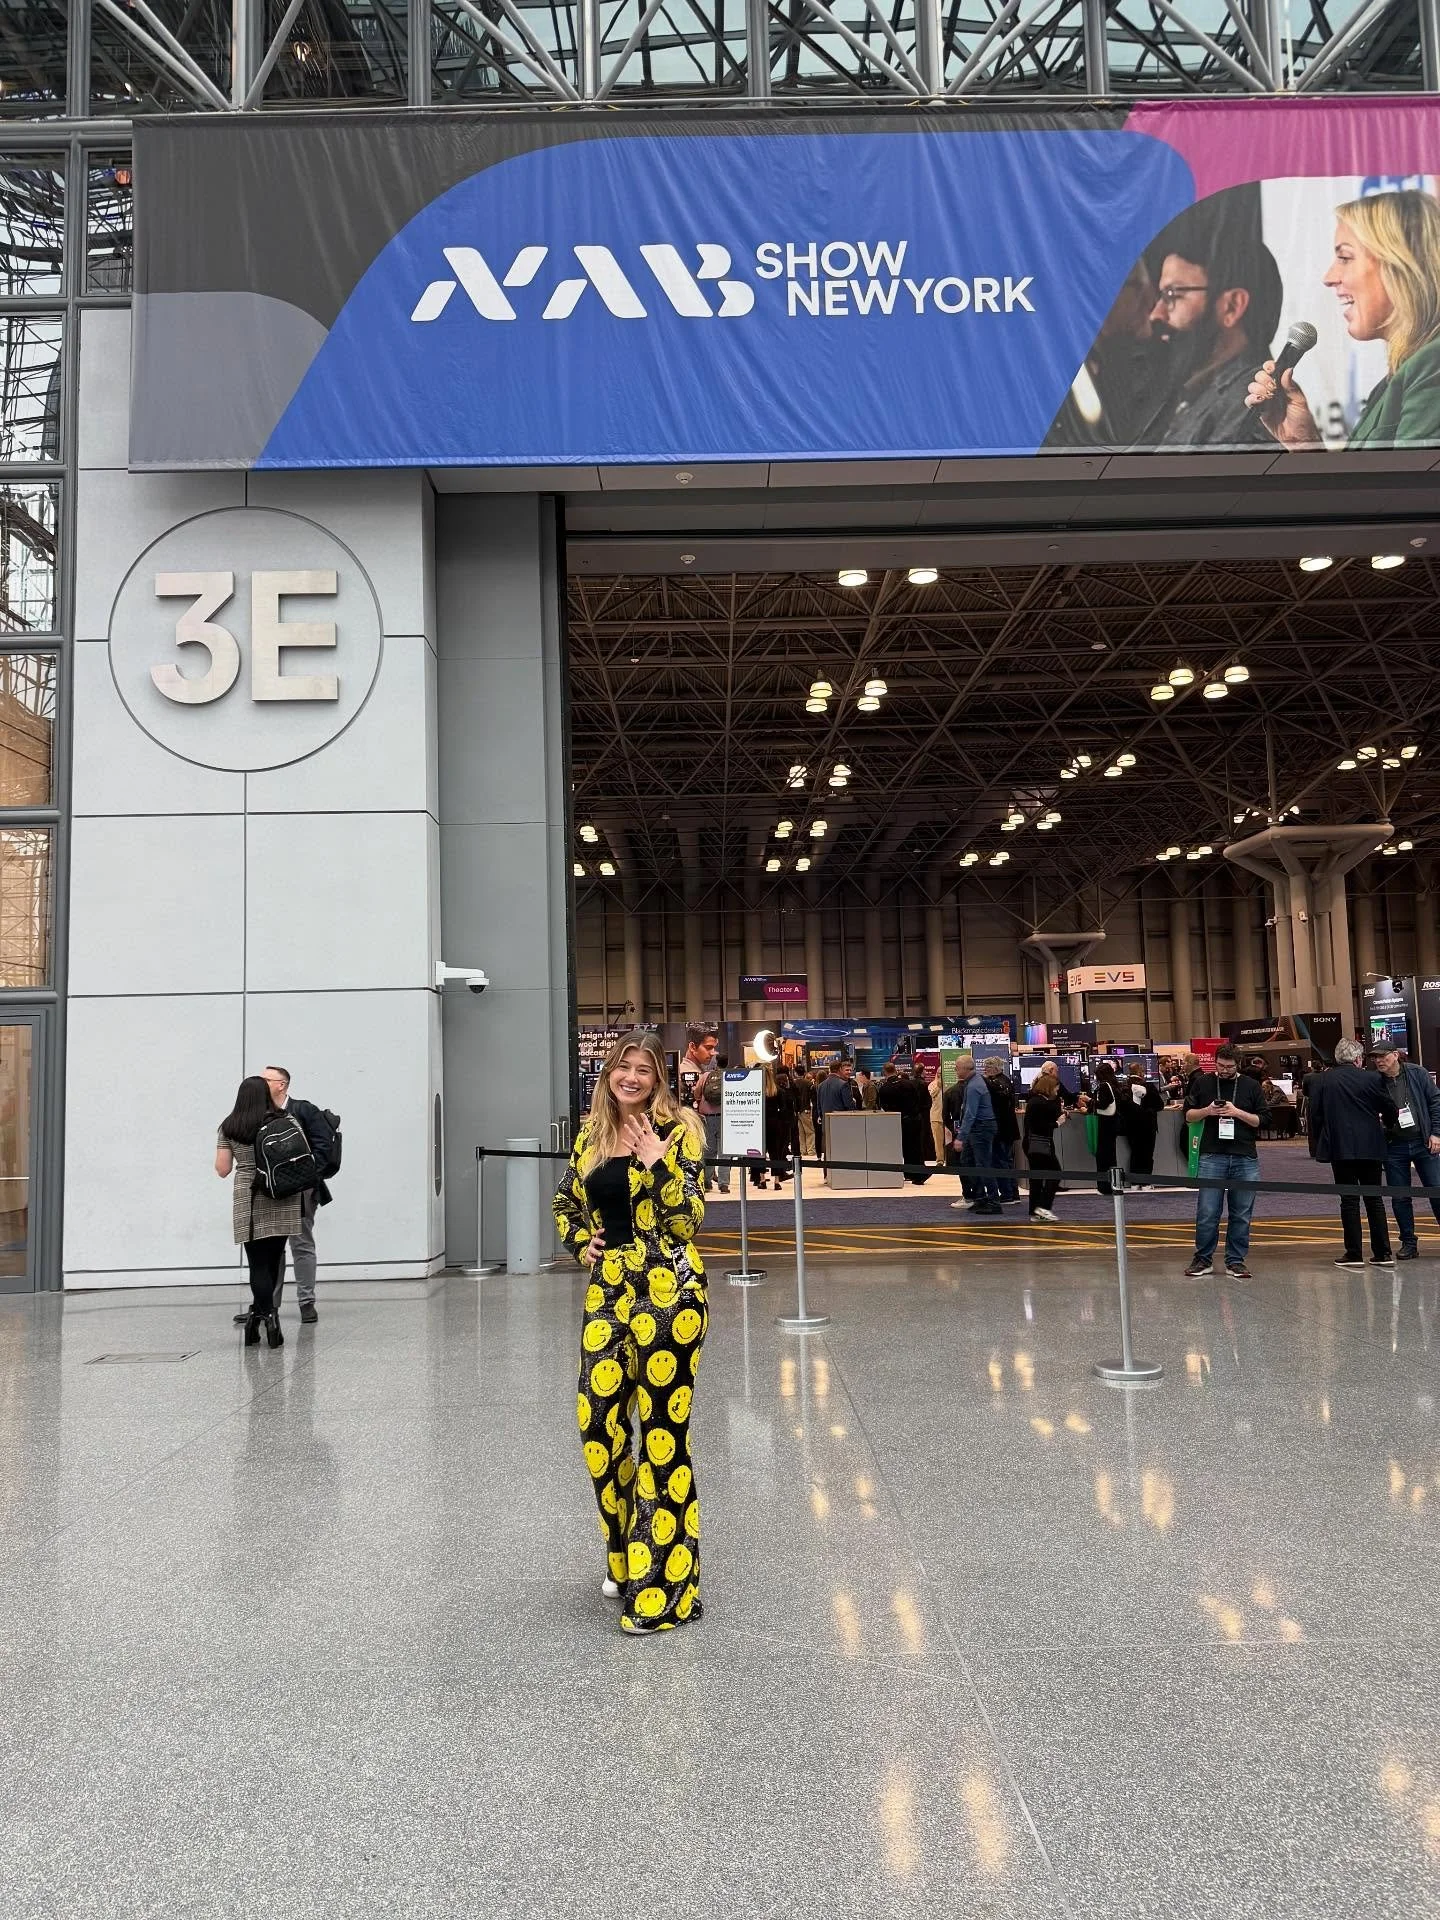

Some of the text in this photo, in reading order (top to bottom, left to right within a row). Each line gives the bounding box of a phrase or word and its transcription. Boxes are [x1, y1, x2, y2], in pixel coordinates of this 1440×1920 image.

[410, 243, 755, 322] NAB
[755, 241, 908, 279] SHOW
[150, 570, 339, 704] 3E
[1094, 971, 1135, 984] EVS
